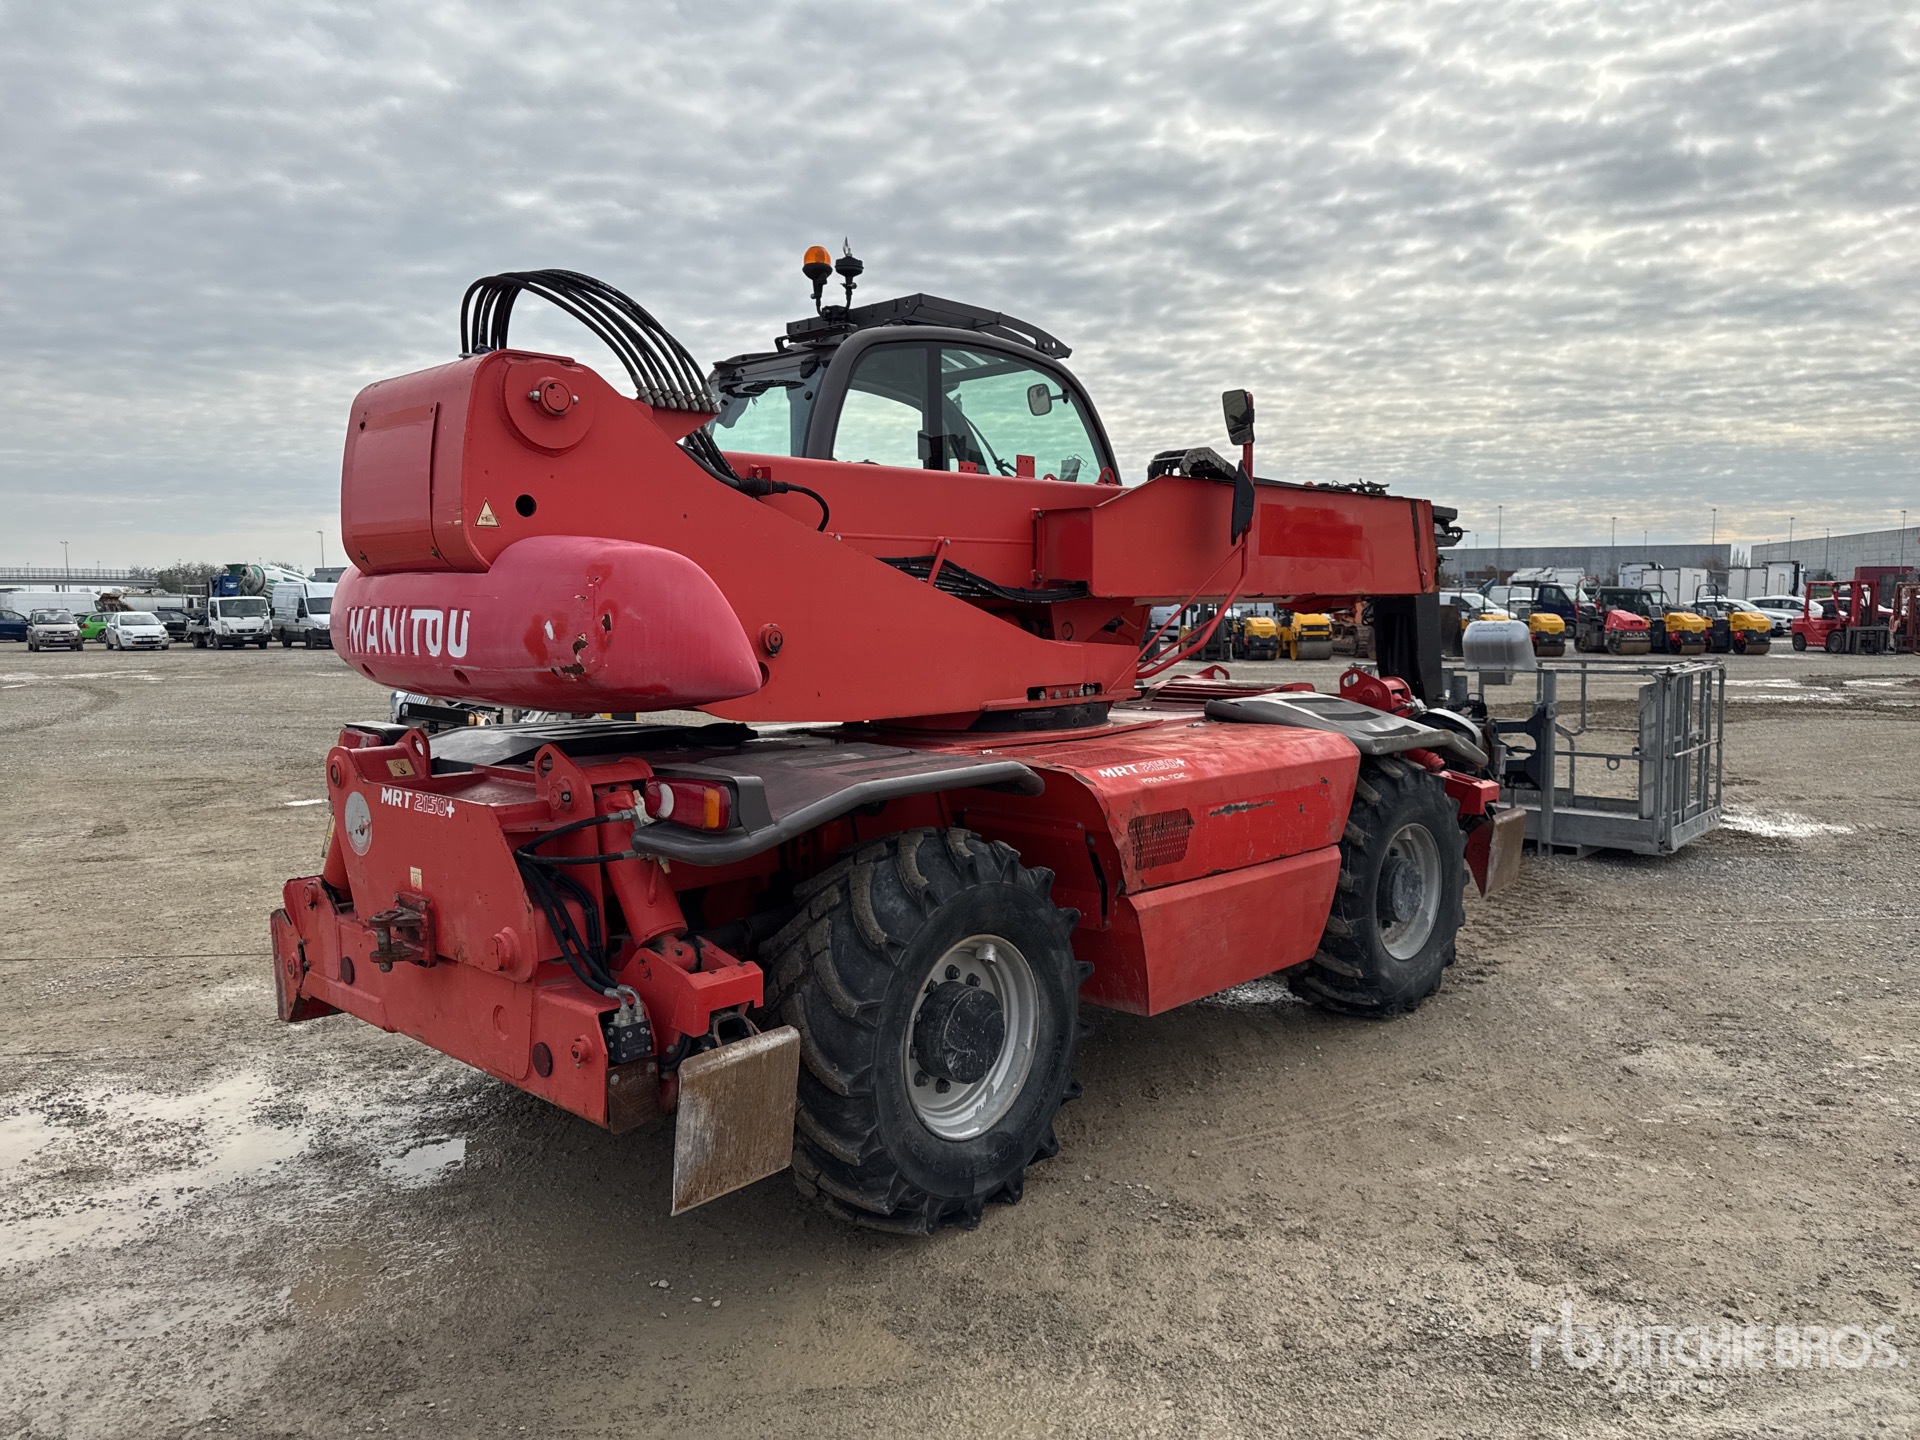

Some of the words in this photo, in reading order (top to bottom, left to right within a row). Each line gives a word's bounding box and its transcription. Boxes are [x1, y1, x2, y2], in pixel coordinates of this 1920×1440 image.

[346, 606, 471, 658] MANITOU
[1097, 764, 1138, 778] MRT
[381, 787, 413, 809] MRT
[414, 793, 455, 818] 2150+
